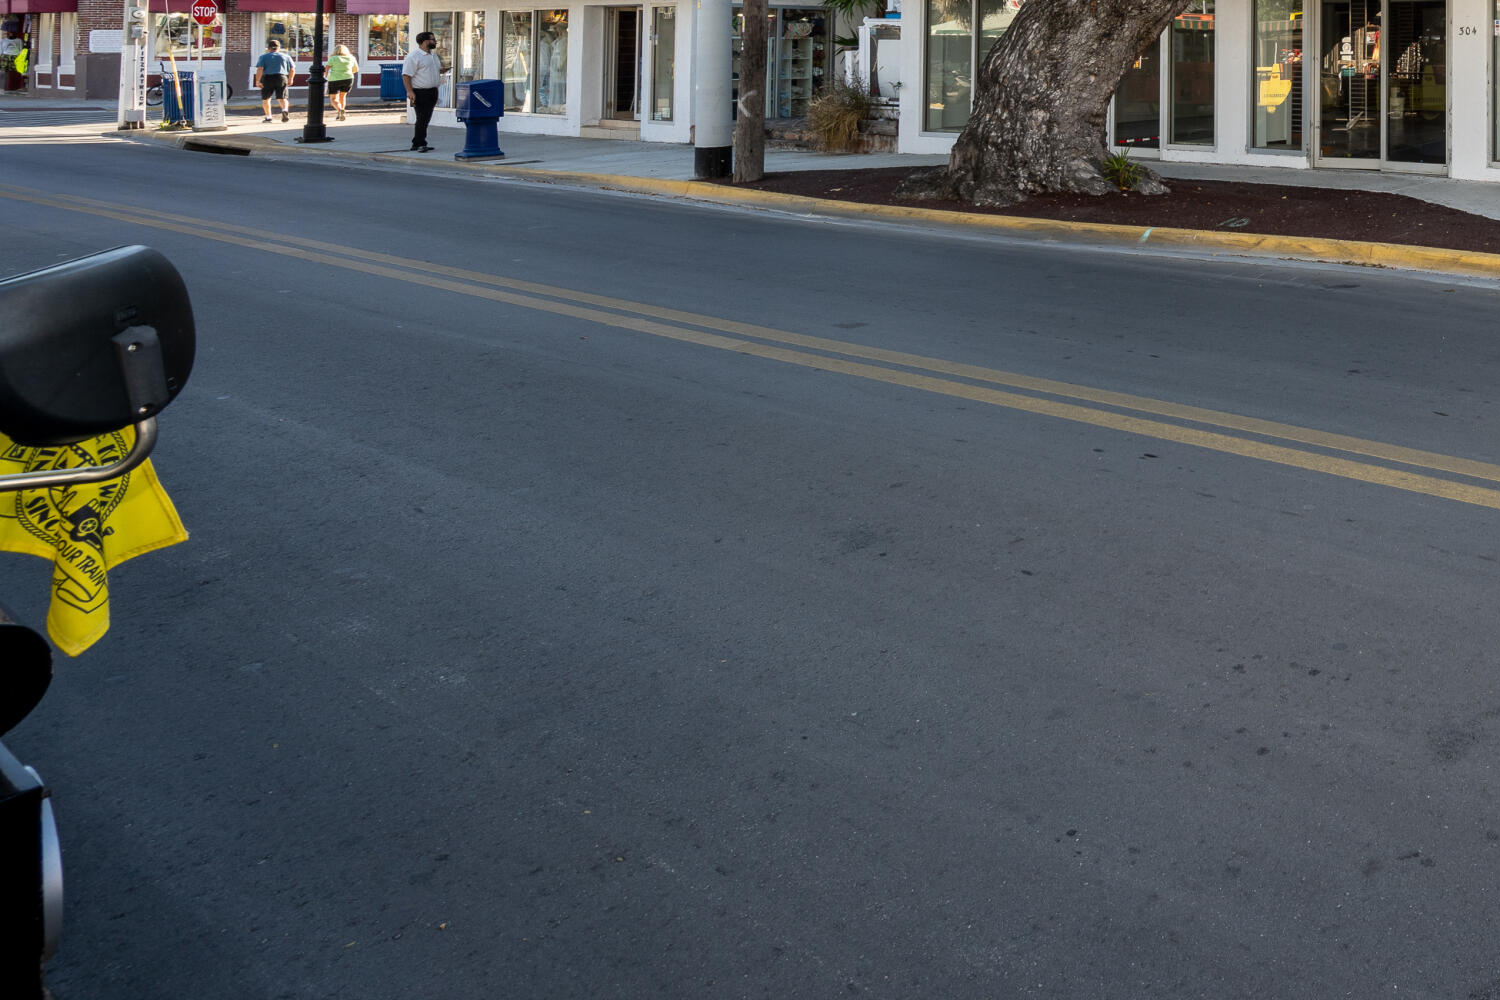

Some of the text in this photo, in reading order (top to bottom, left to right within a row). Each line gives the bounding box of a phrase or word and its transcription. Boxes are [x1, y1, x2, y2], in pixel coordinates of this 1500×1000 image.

[194, 6, 215, 17] STOP
[1458, 26, 1477, 36] 304
[25, 496, 60, 533] SINC
[57, 539, 106, 587] OUR TRAIN
